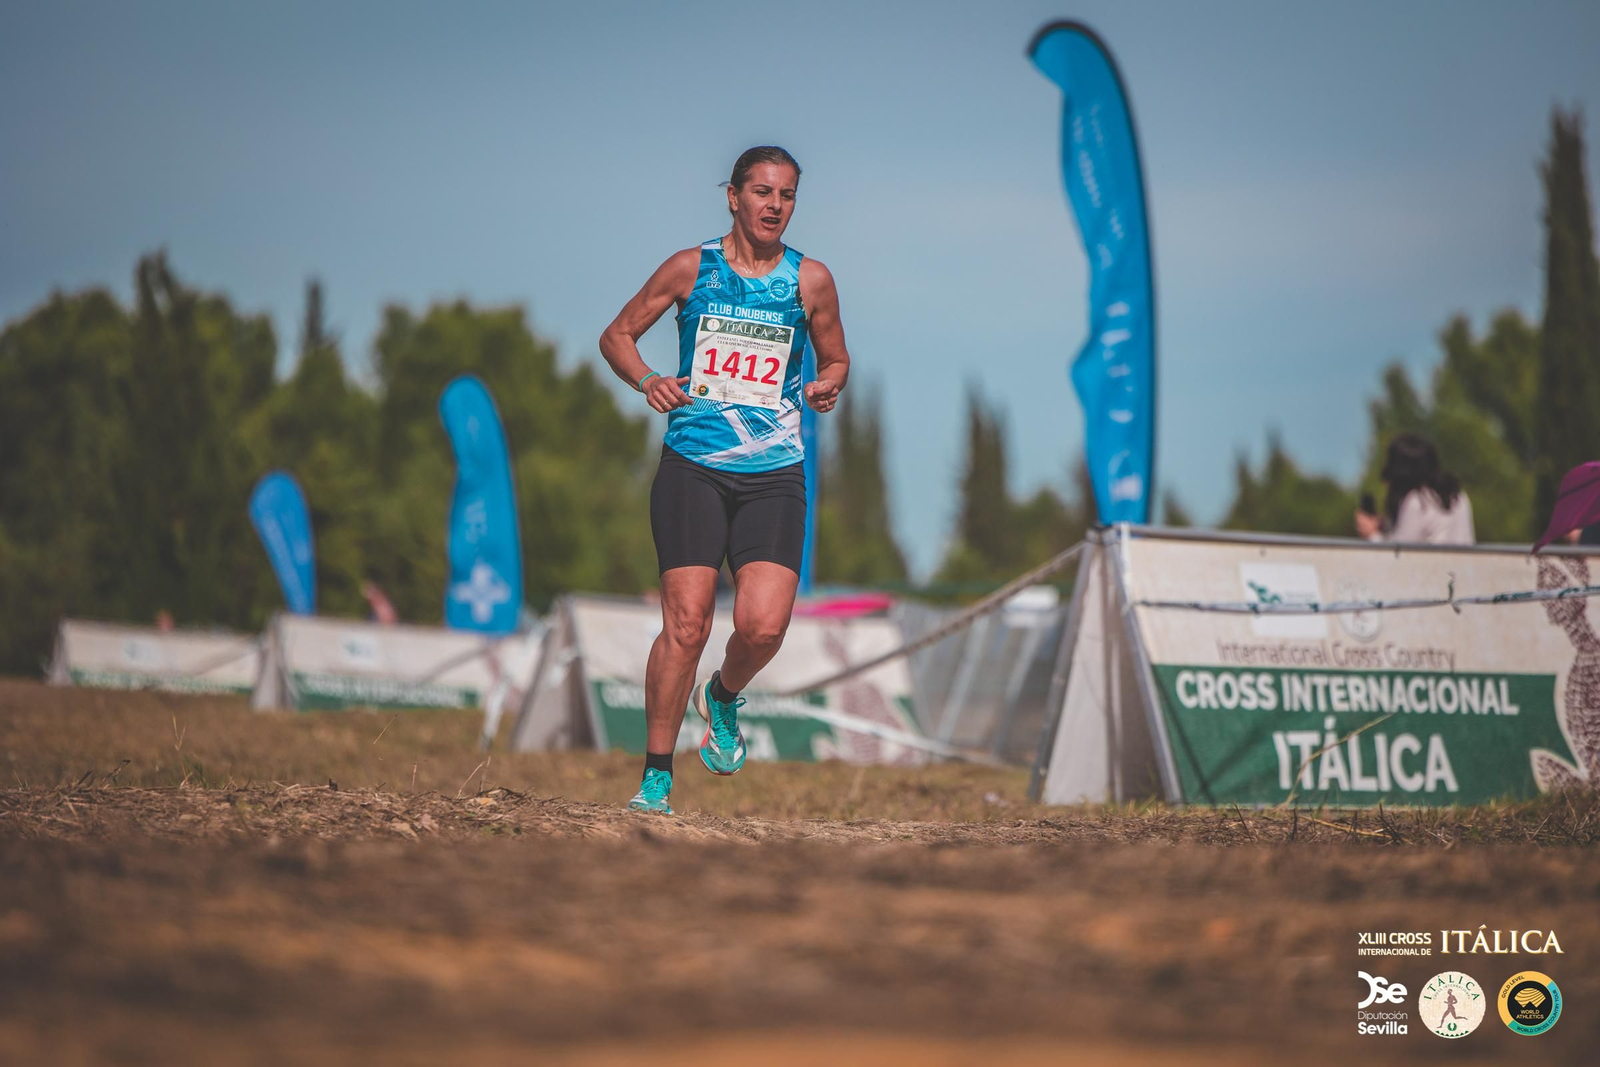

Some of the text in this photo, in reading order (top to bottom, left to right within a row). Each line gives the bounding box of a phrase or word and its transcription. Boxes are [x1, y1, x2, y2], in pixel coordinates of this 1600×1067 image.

[708, 303, 784, 324] CLUB ONUBENSE
[703, 348, 780, 386] 1412
[1217, 640, 1456, 672] International Cross Country
[1175, 669, 1520, 716] CROSS INTERNACIONAL
[1273, 715, 1459, 793] ITÁLICA
